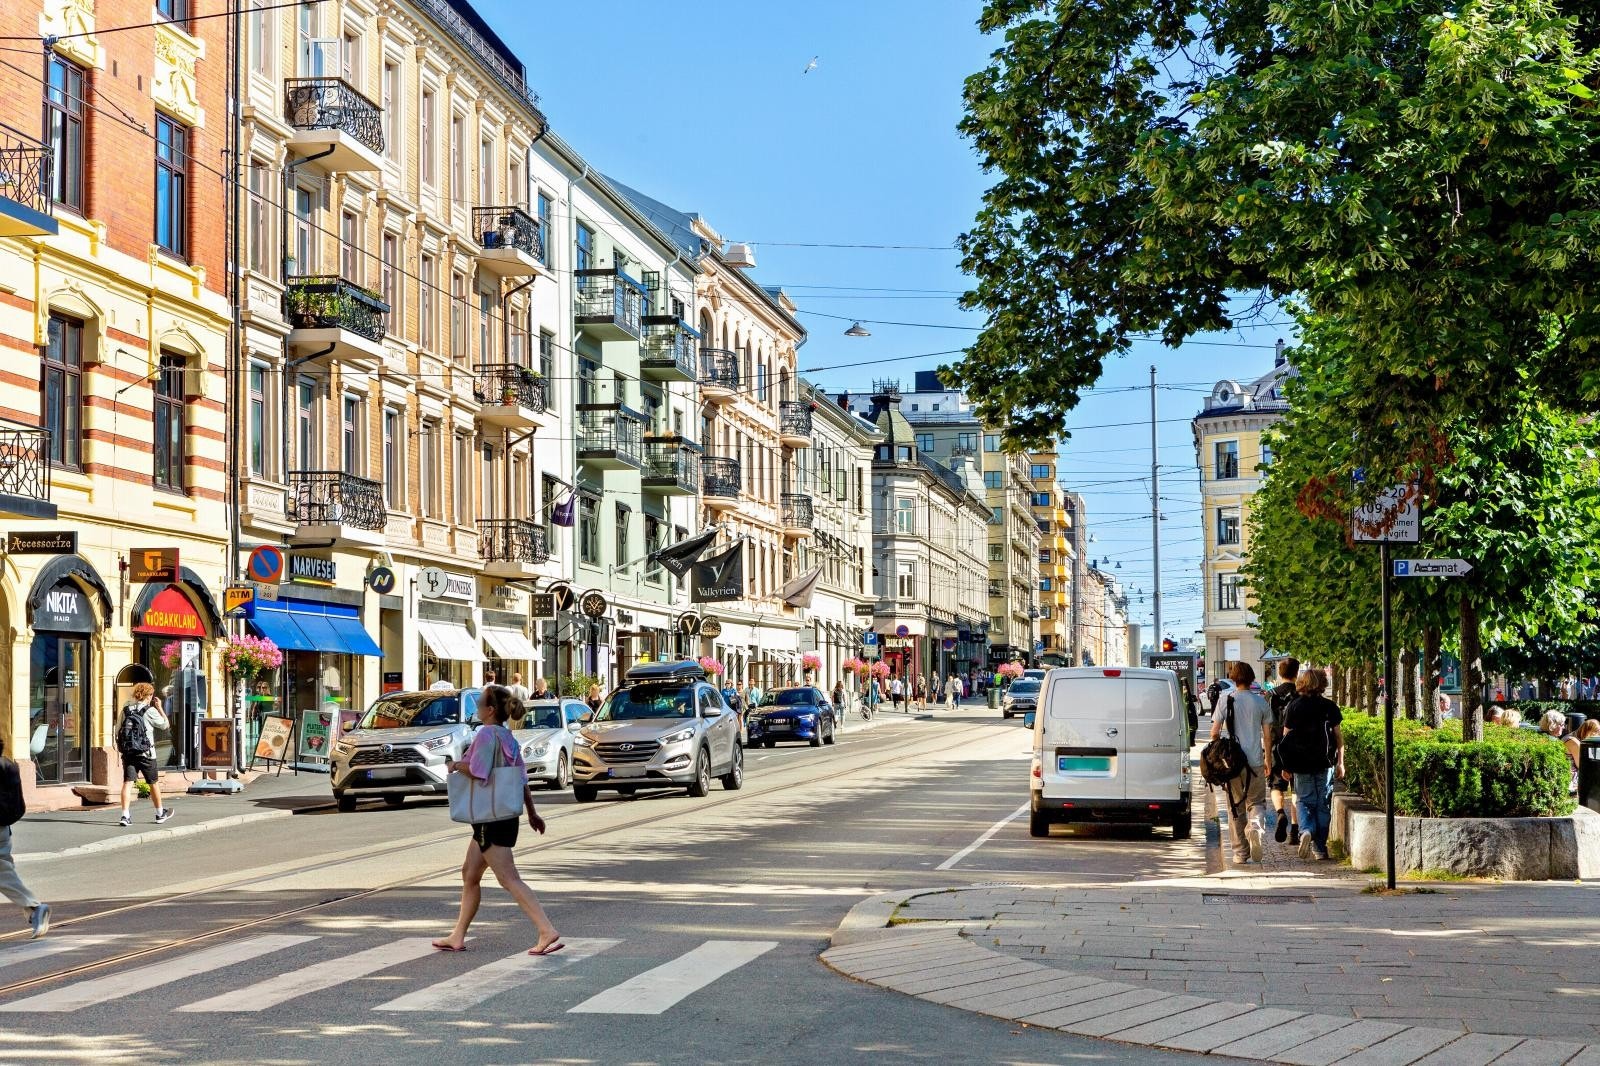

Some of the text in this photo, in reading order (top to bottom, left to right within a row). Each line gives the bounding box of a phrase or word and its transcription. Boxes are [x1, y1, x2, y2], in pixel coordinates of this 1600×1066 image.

[11, 535, 71, 551] Accessorize
[293, 555, 336, 579] NARVESEN
[229, 590, 250, 599] ATM
[448, 578, 472, 595] PIONEERS
[698, 586, 736, 597] Valkyrien
[46, 591, 78, 614] NIKITA
[145, 608, 197, 629] TOBAKKLAND
